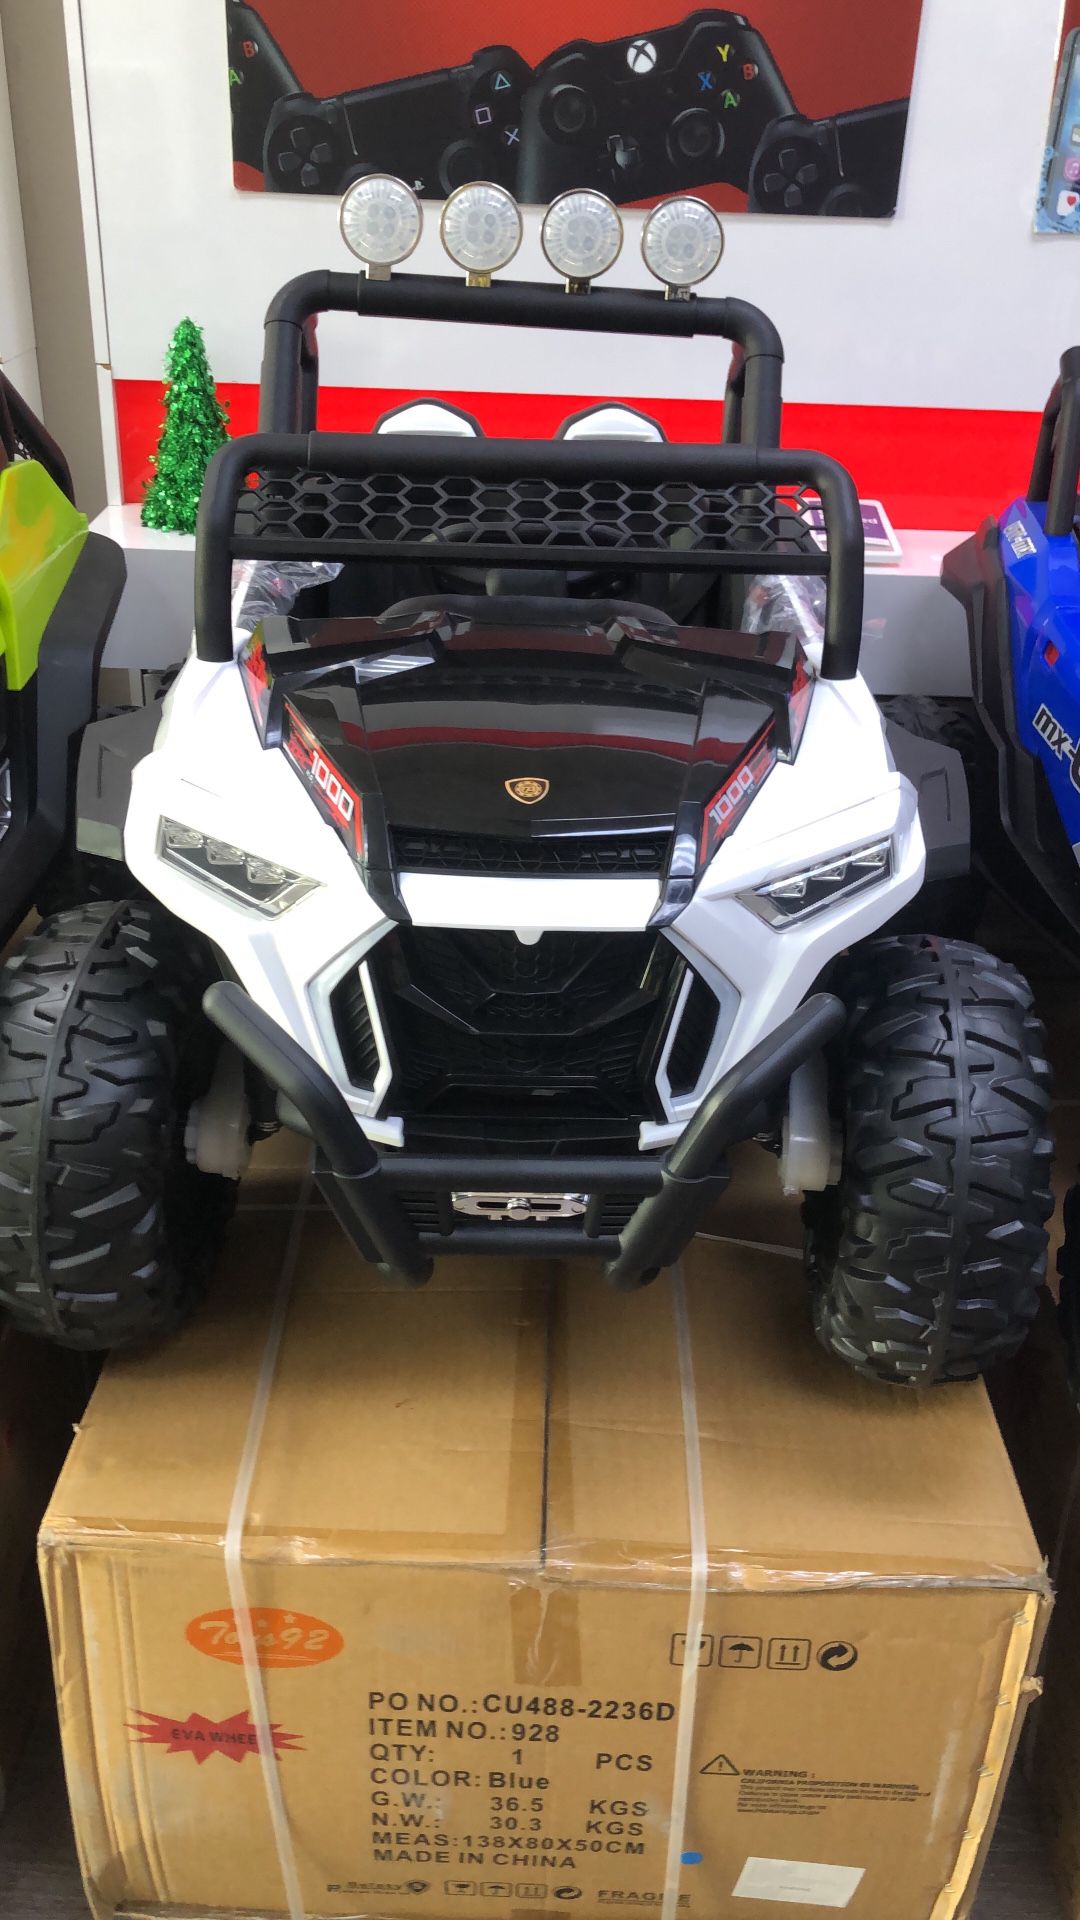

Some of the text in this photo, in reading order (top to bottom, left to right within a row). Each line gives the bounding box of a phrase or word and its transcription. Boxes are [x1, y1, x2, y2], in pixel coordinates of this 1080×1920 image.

[243, 40, 255, 58] B
[716, 43, 730, 62] Y
[698, 71, 713, 91] X
[743, 63, 755, 80] B
[724, 90, 738, 109] A
[311, 750, 355, 822] 1000
[708, 765, 754, 825] 1000
[368, 1691, 408, 1711] PO
[171, 1727, 260, 1745] EVA WHEE
[368, 1718, 437, 1738] ITEM
[369, 1743, 653, 1772] QTY: 1 PCS
[370, 1767, 550, 1790] COLOR: Blue
[742, 1768, 808, 1779] WARNING
[370, 1790, 649, 1817] G.W.: 36.5 KGS
[371, 1812, 644, 1837] N.W.: 30.3 KGS
[373, 1849, 577, 1869] MADE IN CHINA
[598, 1890, 691, 1902] FRAGIE
